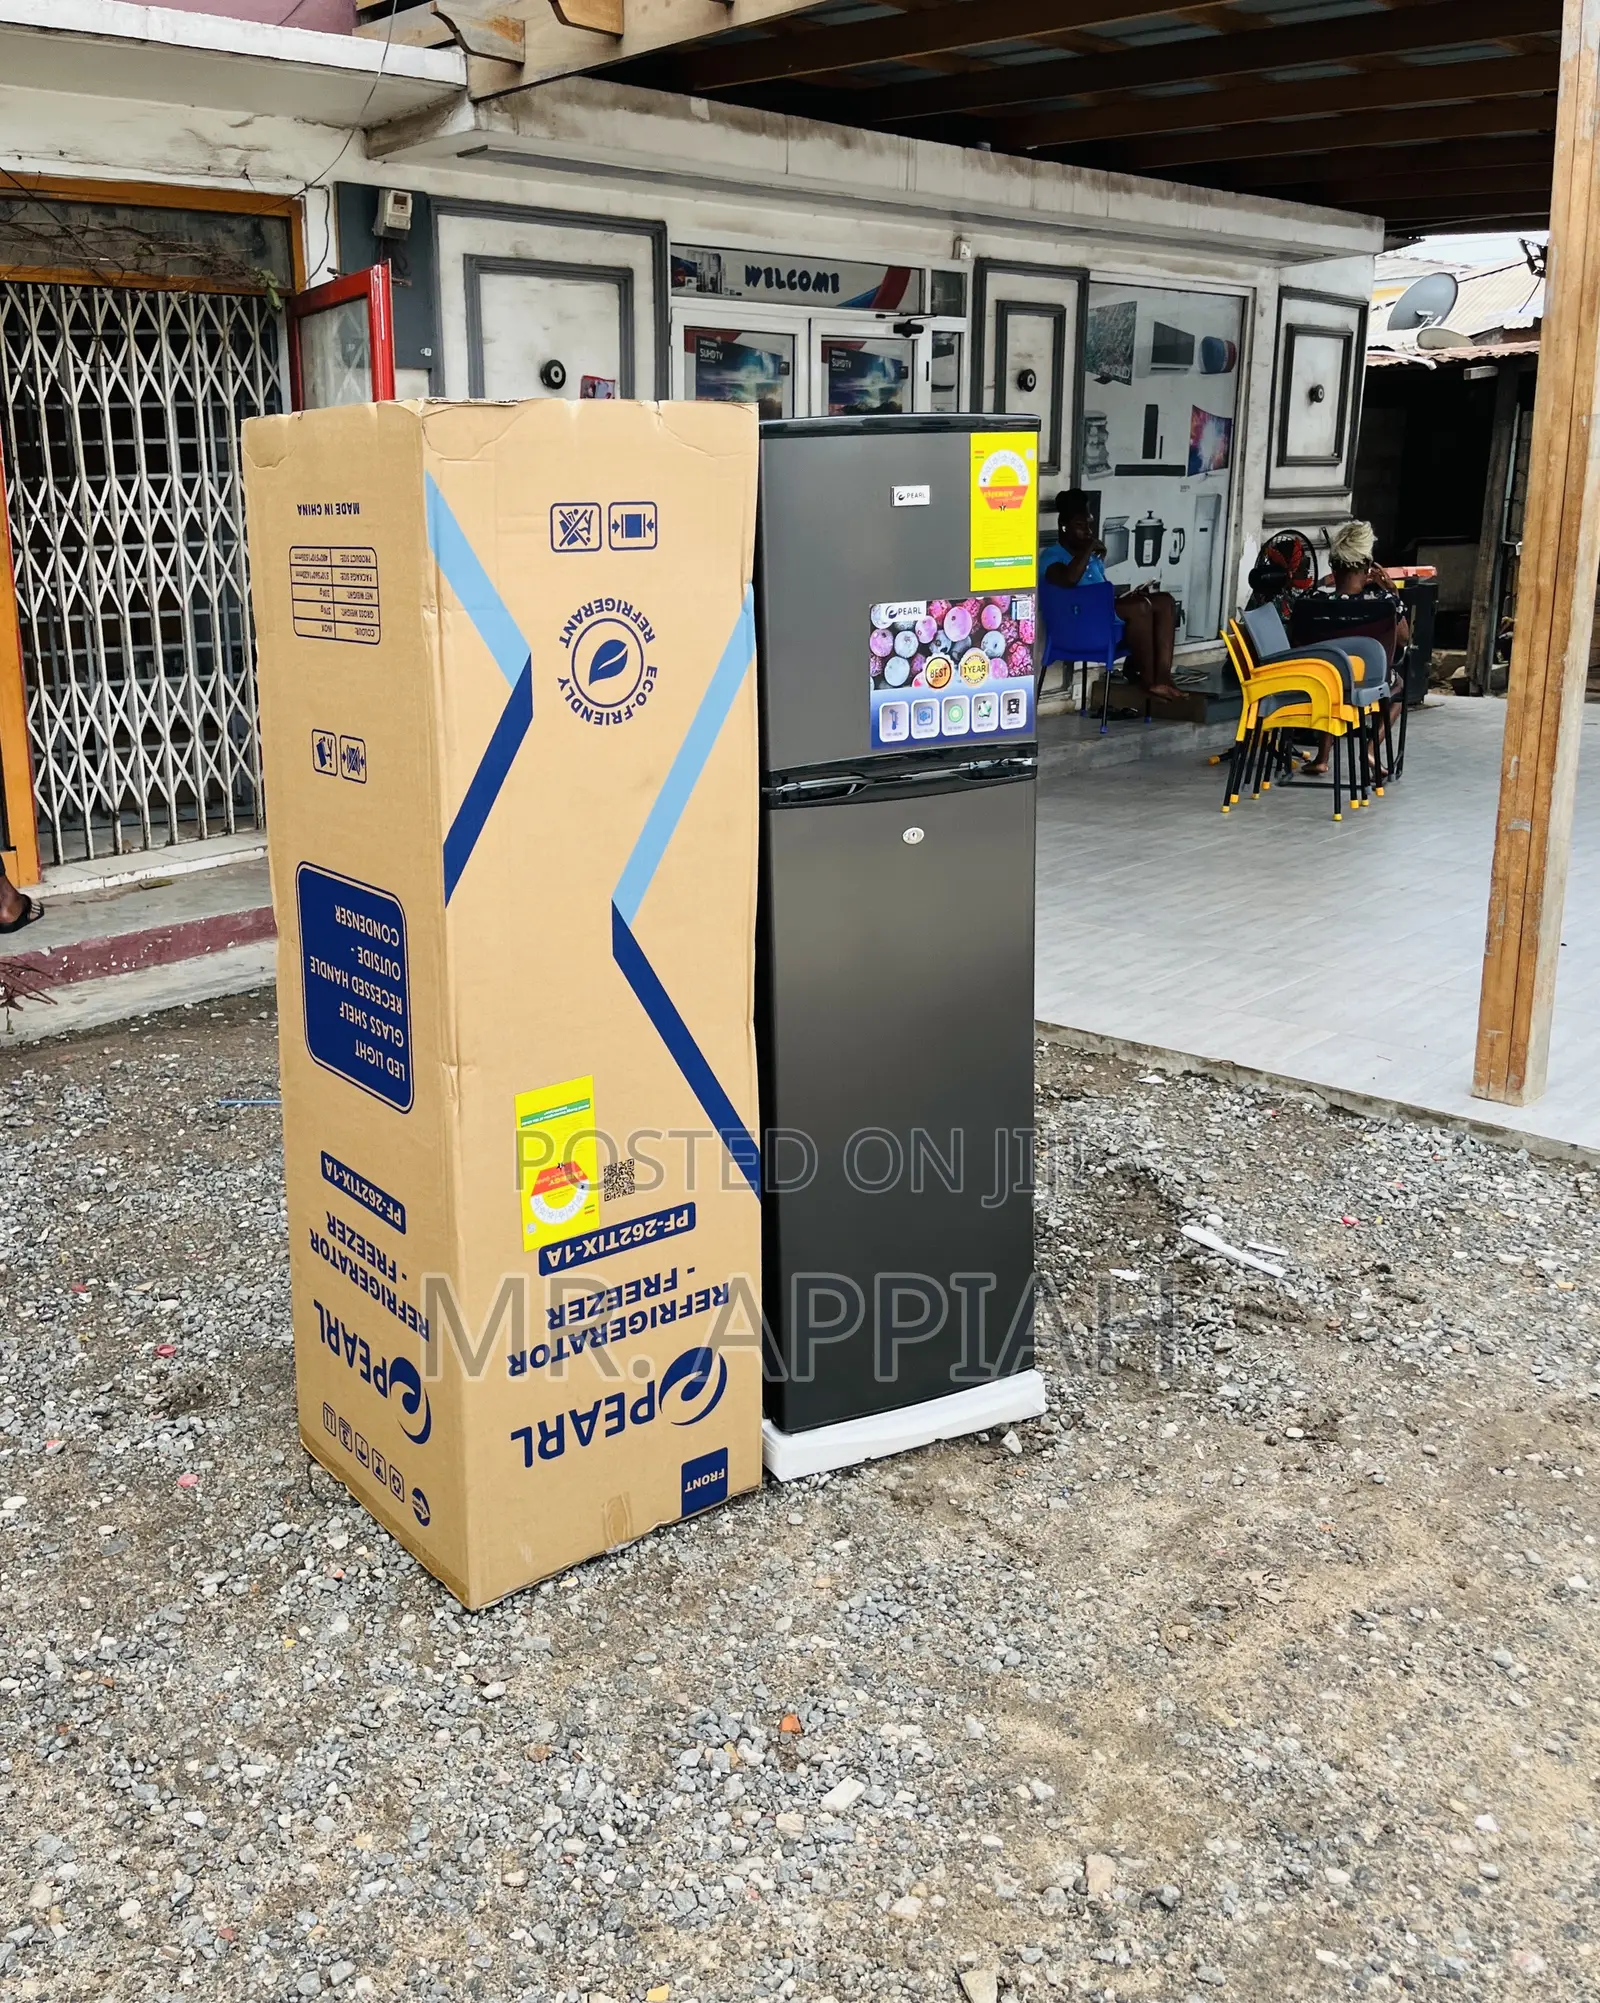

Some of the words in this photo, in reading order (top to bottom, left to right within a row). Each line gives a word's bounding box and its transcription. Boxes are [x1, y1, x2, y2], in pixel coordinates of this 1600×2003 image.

[744, 264, 840, 294] WELCOME
[296, 504, 322, 516] CHINA
[324, 504, 334, 515] IN
[336, 503, 360, 515] MADE
[558, 597, 656, 649] REFRIGERANT
[898, 608, 922, 616] PEARL
[930, 668, 948, 678] BEST
[968, 665, 986, 673] YEAR
[557, 665, 658, 726] ECO-FRIENDLY
[334, 904, 399, 947] CONDENSER
[310, 956, 349, 989] HANDLE
[357, 946, 400, 980] OUTSIDE
[352, 976, 402, 1015] RECESSED
[340, 1001, 368, 1030] SHELF
[370, 1016, 404, 1048] GLASS
[354, 1039, 384, 1070] LIGHT
[386, 1056, 406, 1082] LED
[324, 1158, 402, 1226] PF-262TIX-1A
[326, 1210, 396, 1284] FREEZER
[546, 1209, 688, 1267] PF-262TIX-1A
[309, 1228, 430, 1342] REFRIGERATOR
[546, 1267, 678, 1330] FREEZER
[506, 1282, 729, 1376] REFRIGERATOR
[314, 1298, 388, 1398] PEARL
[510, 1380, 655, 1468] PEARL
[684, 1468, 725, 1492] FRONT
